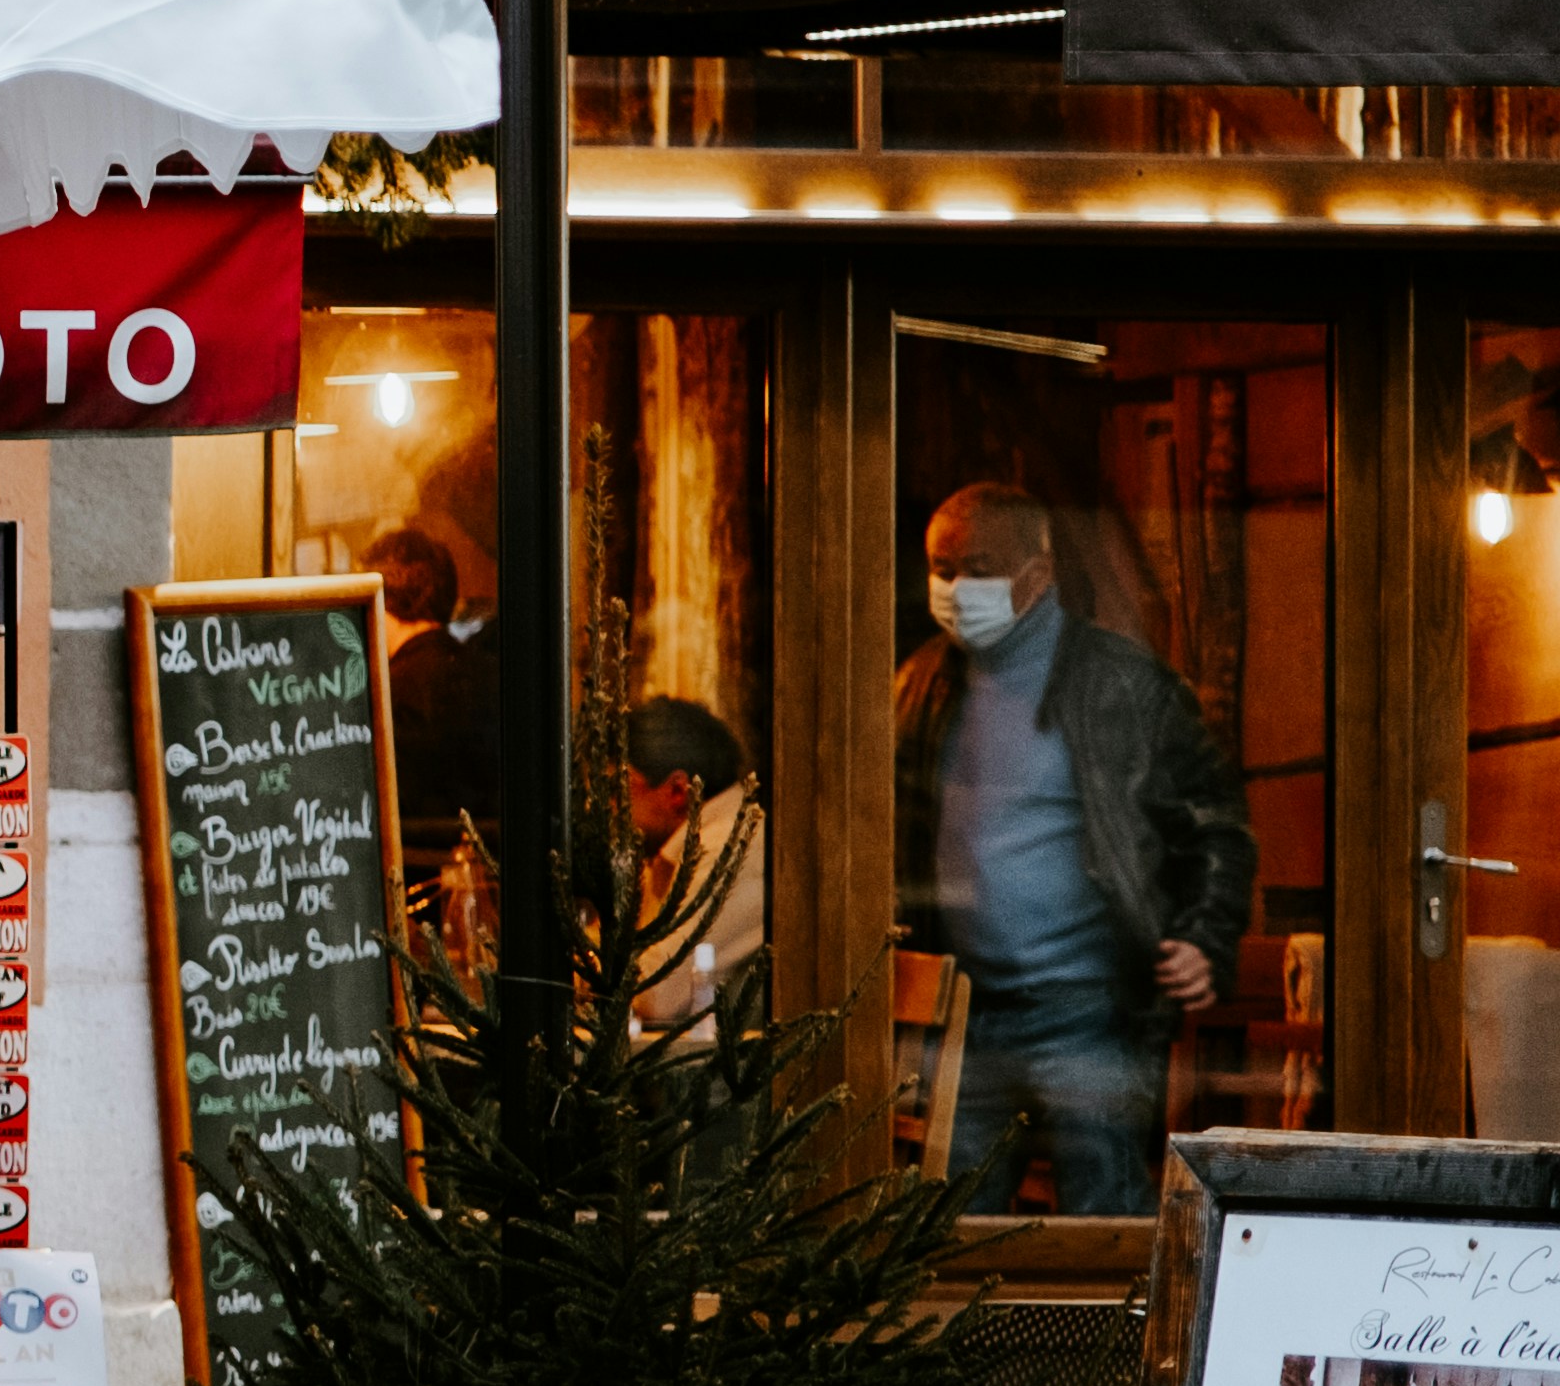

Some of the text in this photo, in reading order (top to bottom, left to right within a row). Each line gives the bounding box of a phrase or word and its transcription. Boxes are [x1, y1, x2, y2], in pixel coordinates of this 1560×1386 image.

[248, 665, 342, 707] VEGAN
[15, 1343, 55, 1362] AN
[1350, 1309, 1452, 1359] Salle
[1460, 1325, 1488, 1357] à
